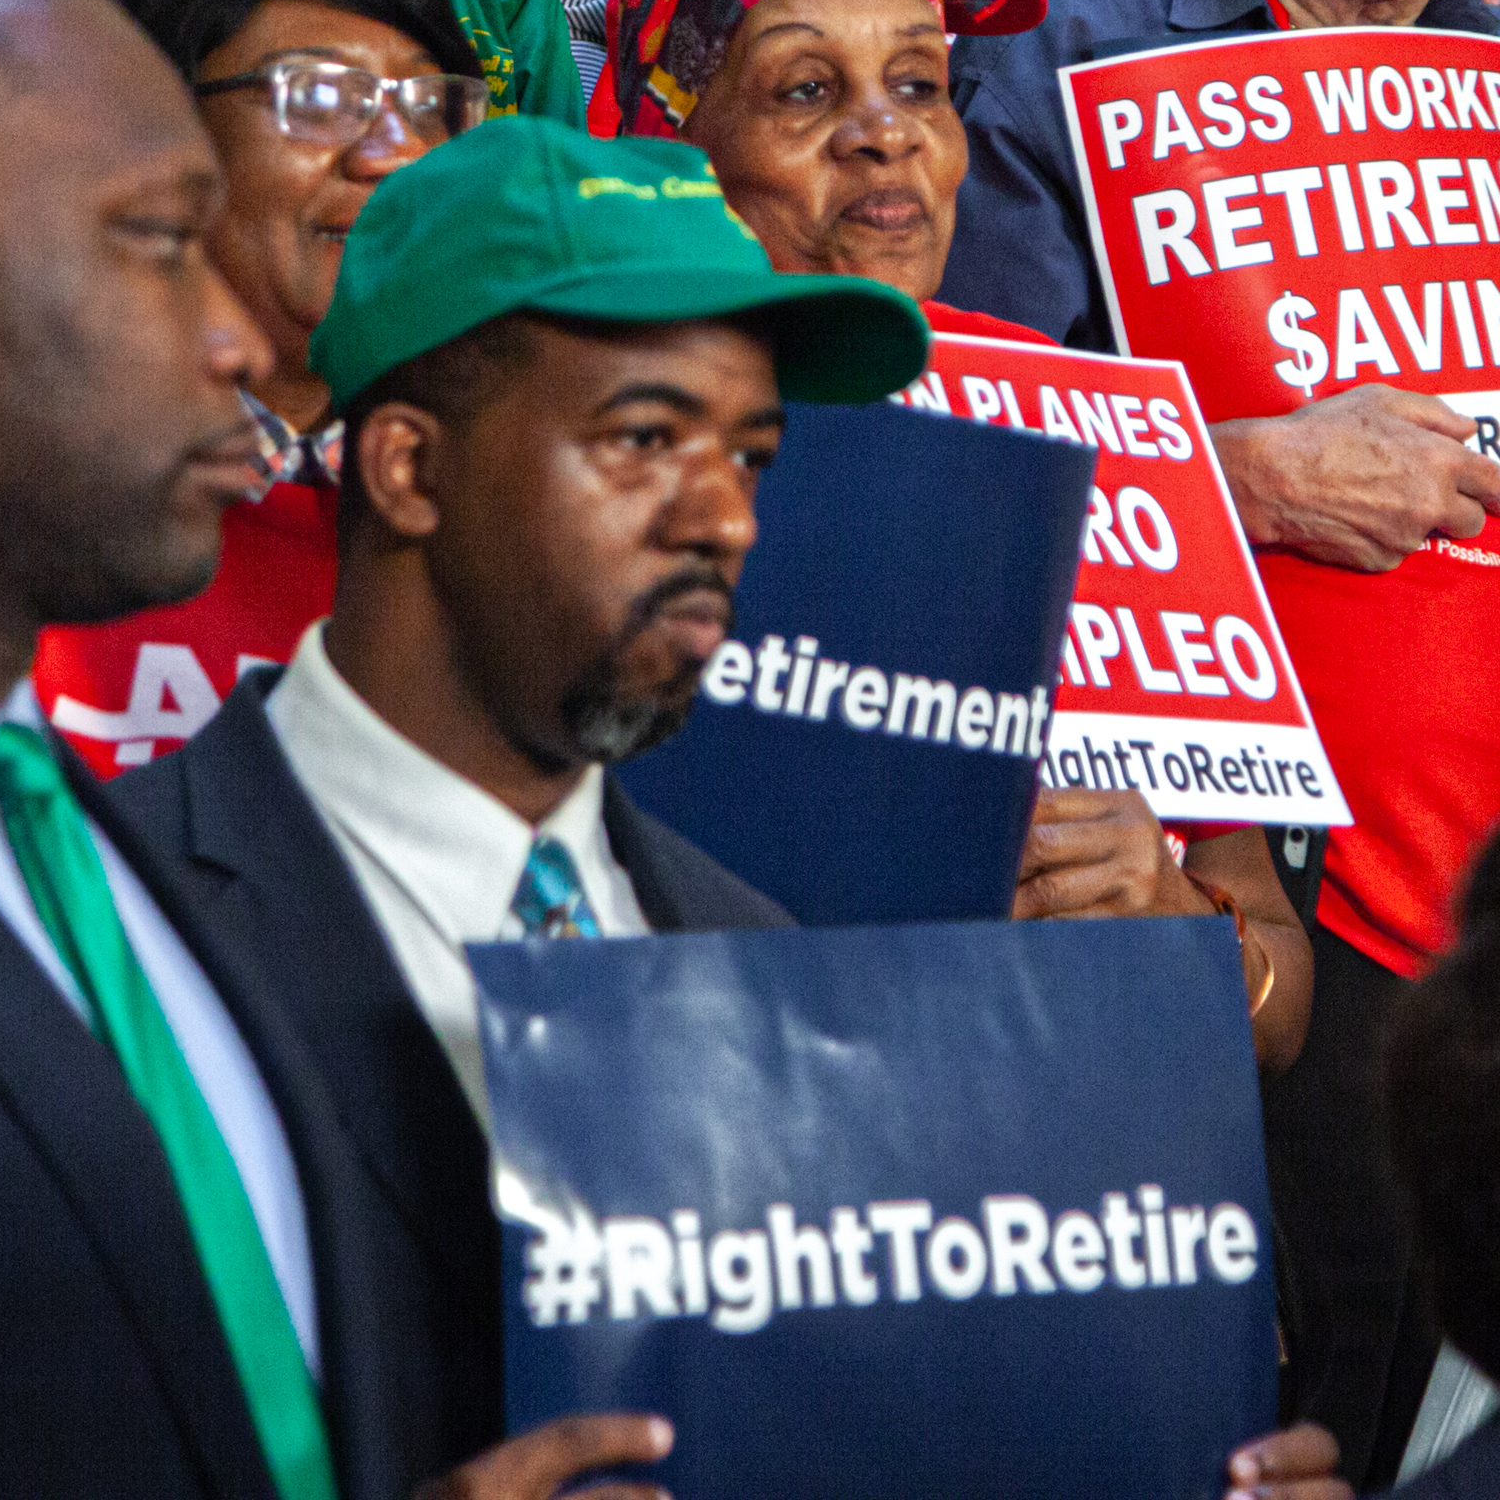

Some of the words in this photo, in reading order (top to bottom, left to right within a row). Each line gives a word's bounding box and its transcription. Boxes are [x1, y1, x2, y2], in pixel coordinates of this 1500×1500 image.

[1097, 74, 1292, 169] PASS
[704, 634, 1051, 760] etirement
[1058, 602, 1278, 702] PLEO
[524, 1184, 1260, 1333] #RightToRetire
